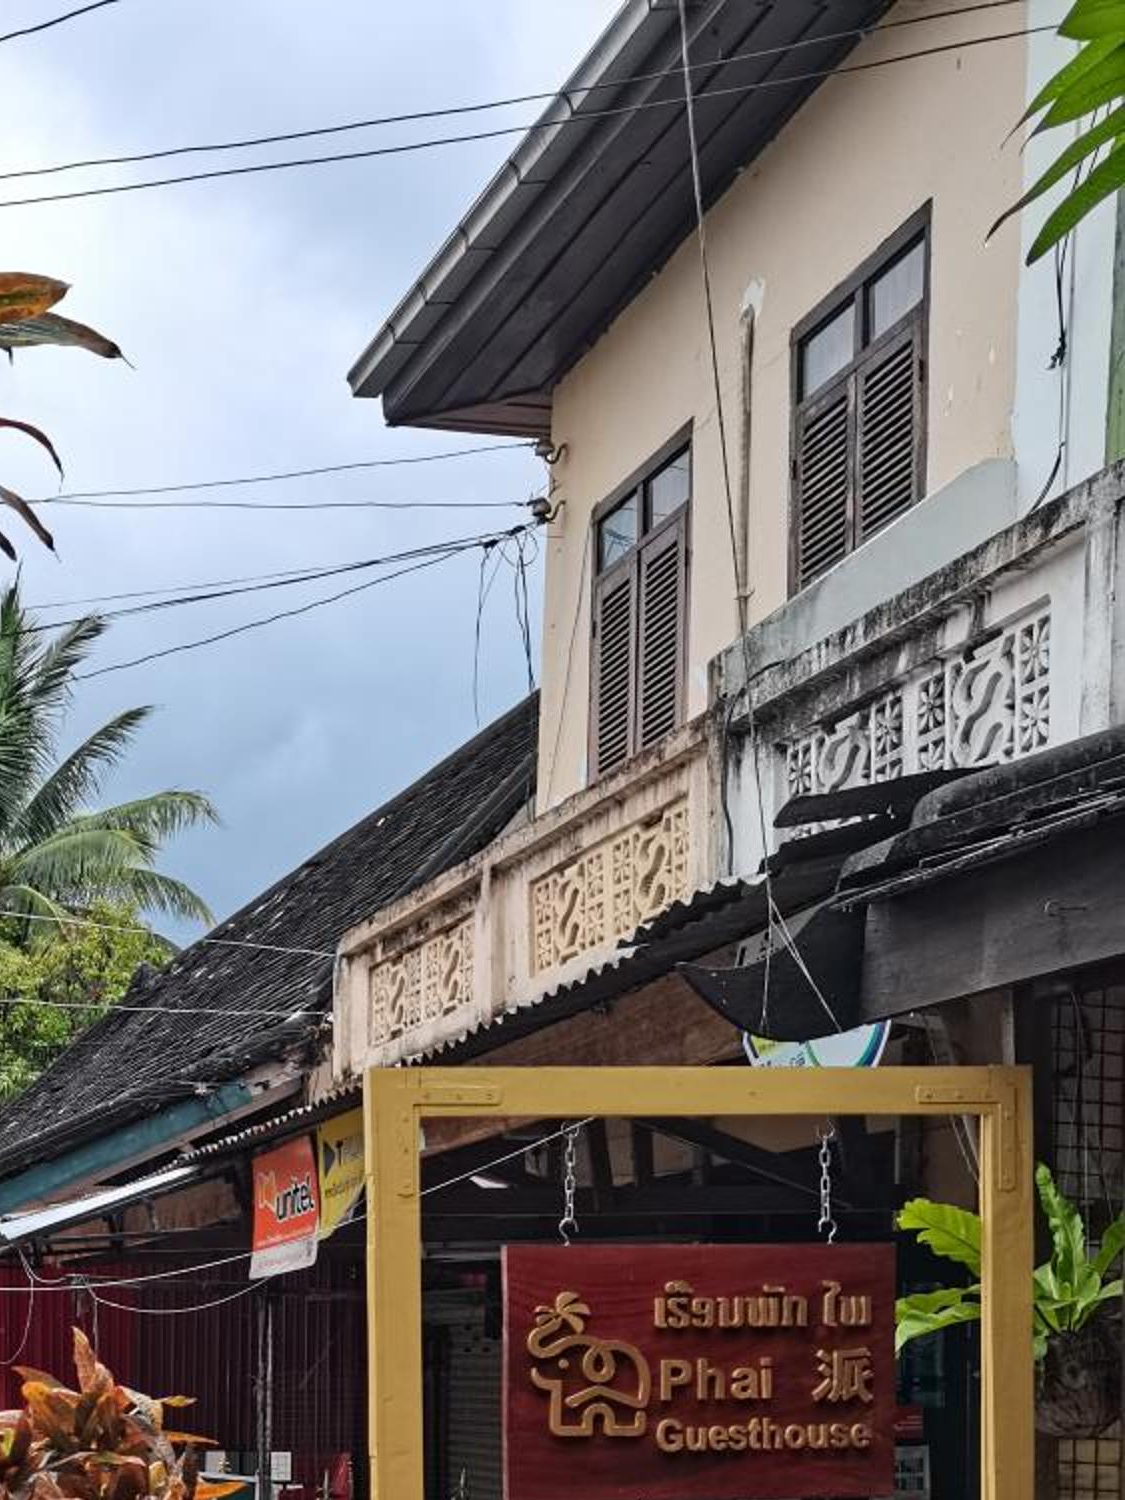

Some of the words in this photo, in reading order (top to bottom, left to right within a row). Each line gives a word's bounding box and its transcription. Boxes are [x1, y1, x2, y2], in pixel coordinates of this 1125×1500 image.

[660, 1357, 772, 1400] Phai
[811, 1347, 874, 1402] 派
[656, 1417, 873, 1452] Guesthouse
